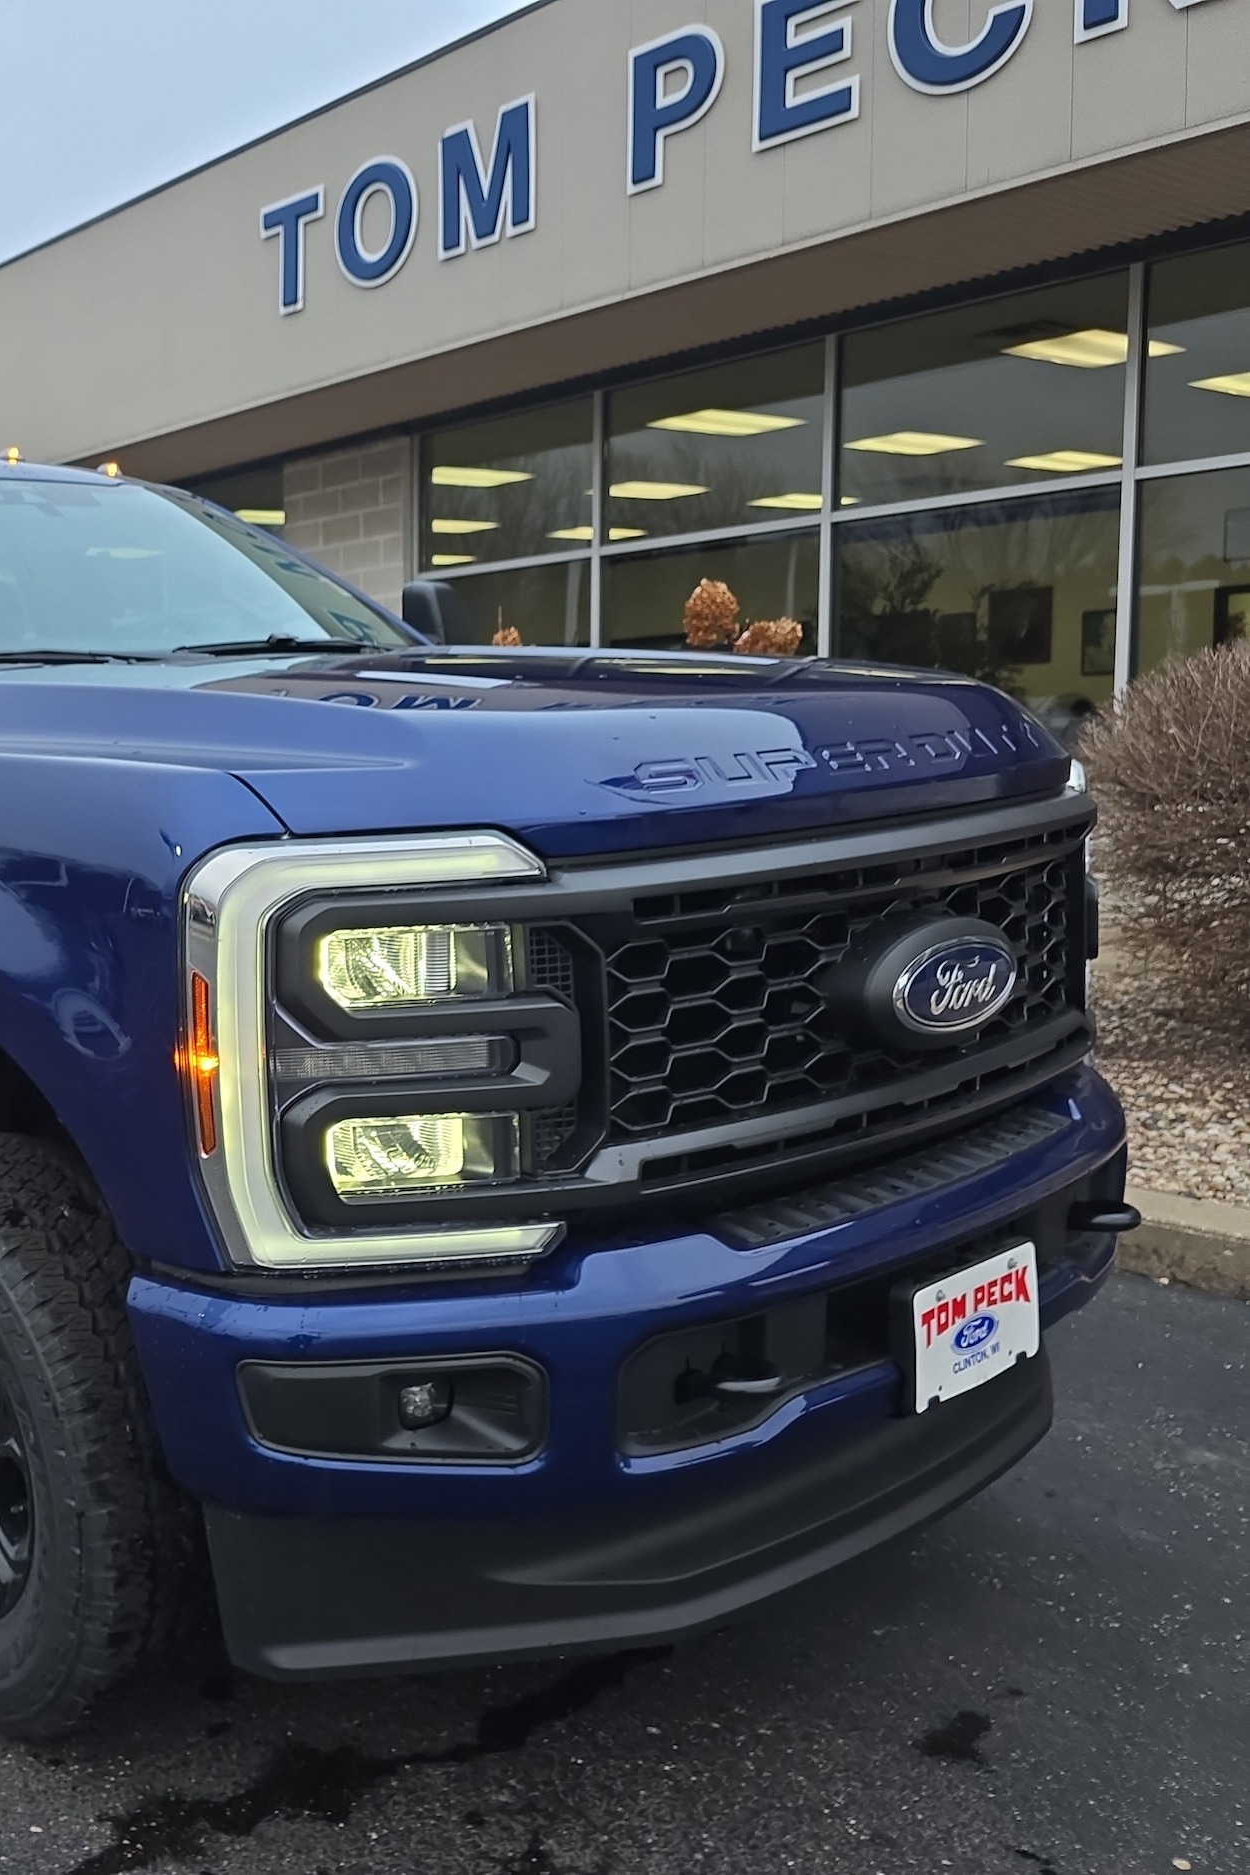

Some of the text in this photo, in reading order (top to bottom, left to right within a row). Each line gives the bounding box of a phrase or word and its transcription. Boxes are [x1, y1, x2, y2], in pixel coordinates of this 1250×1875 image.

[259, 0, 1216, 315] TOM PEC
[633, 739, 916, 795] SUPER
[930, 954, 997, 1016] Ford
[921, 1265, 1031, 1349] TOM PECK
[960, 1319, 990, 1347] Ford
[952, 1341, 1000, 1374] CLINTON, WI
